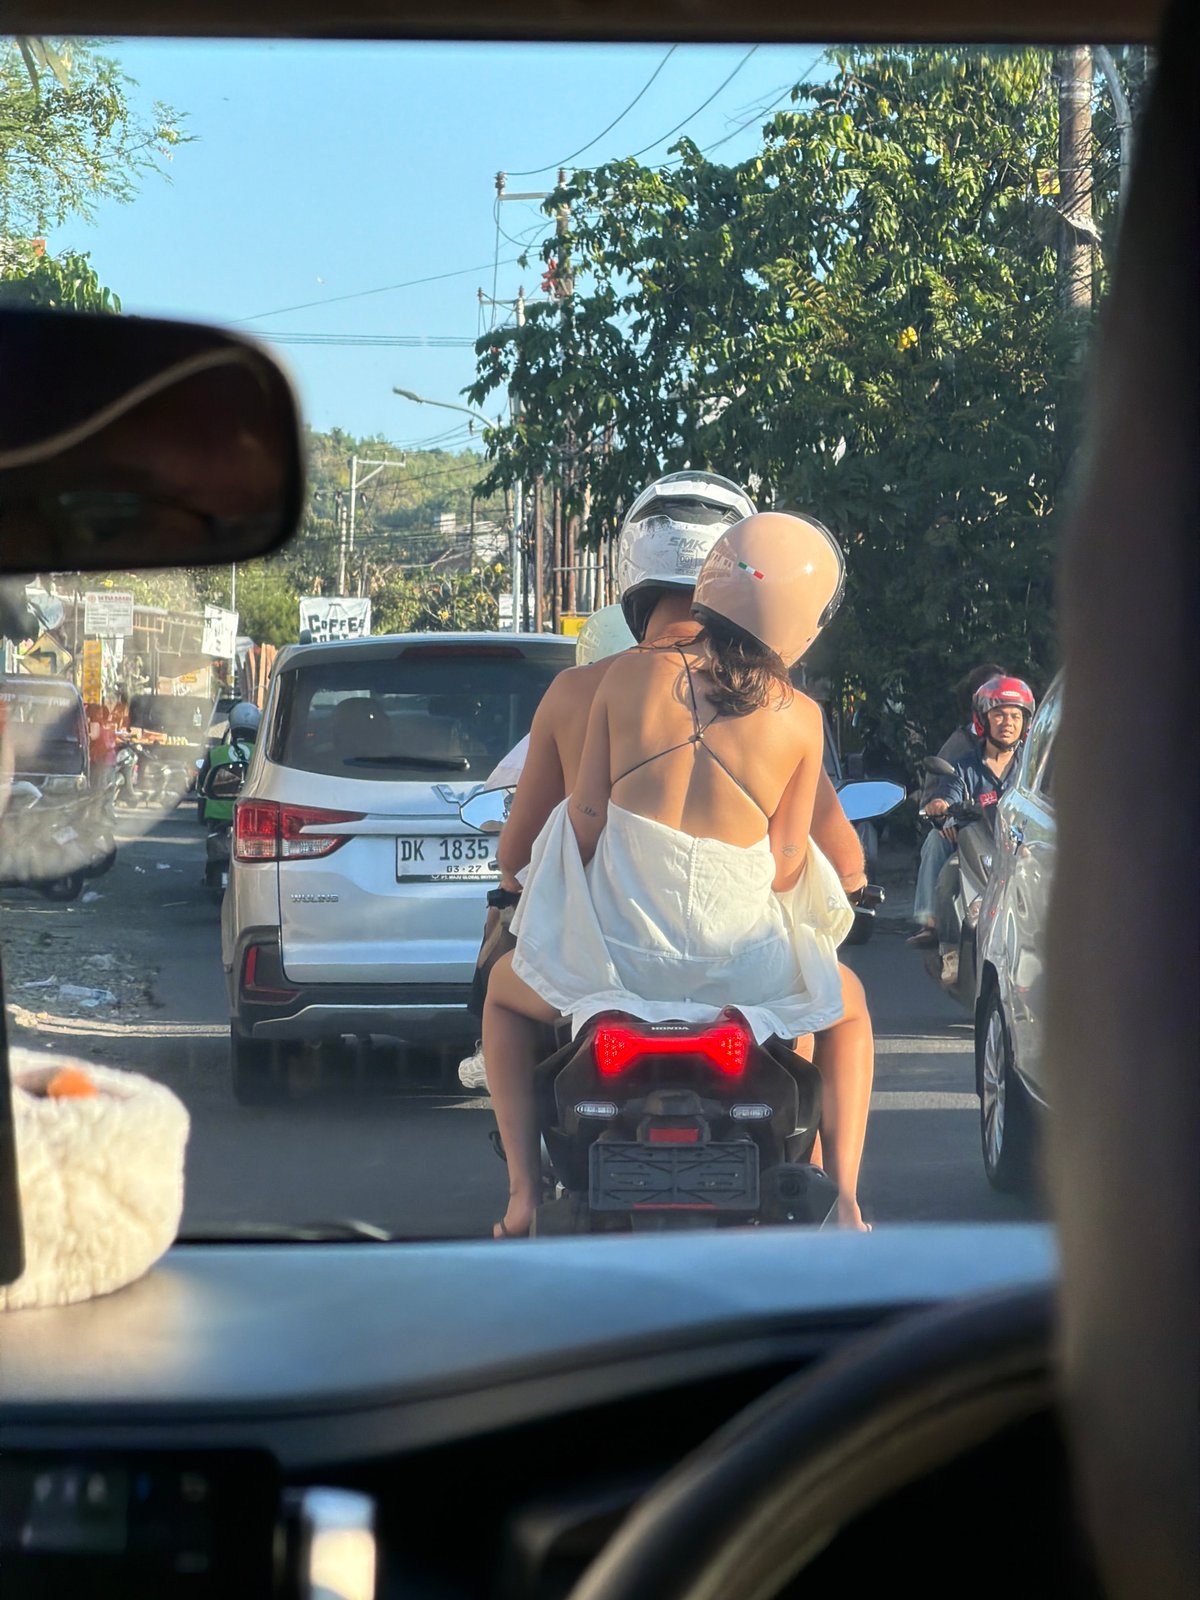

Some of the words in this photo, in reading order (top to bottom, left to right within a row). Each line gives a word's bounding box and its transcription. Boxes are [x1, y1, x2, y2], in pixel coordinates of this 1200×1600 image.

[308, 615, 365, 634] COFFEE
[401, 839, 425, 861] DK
[440, 838, 489, 860] 1835
